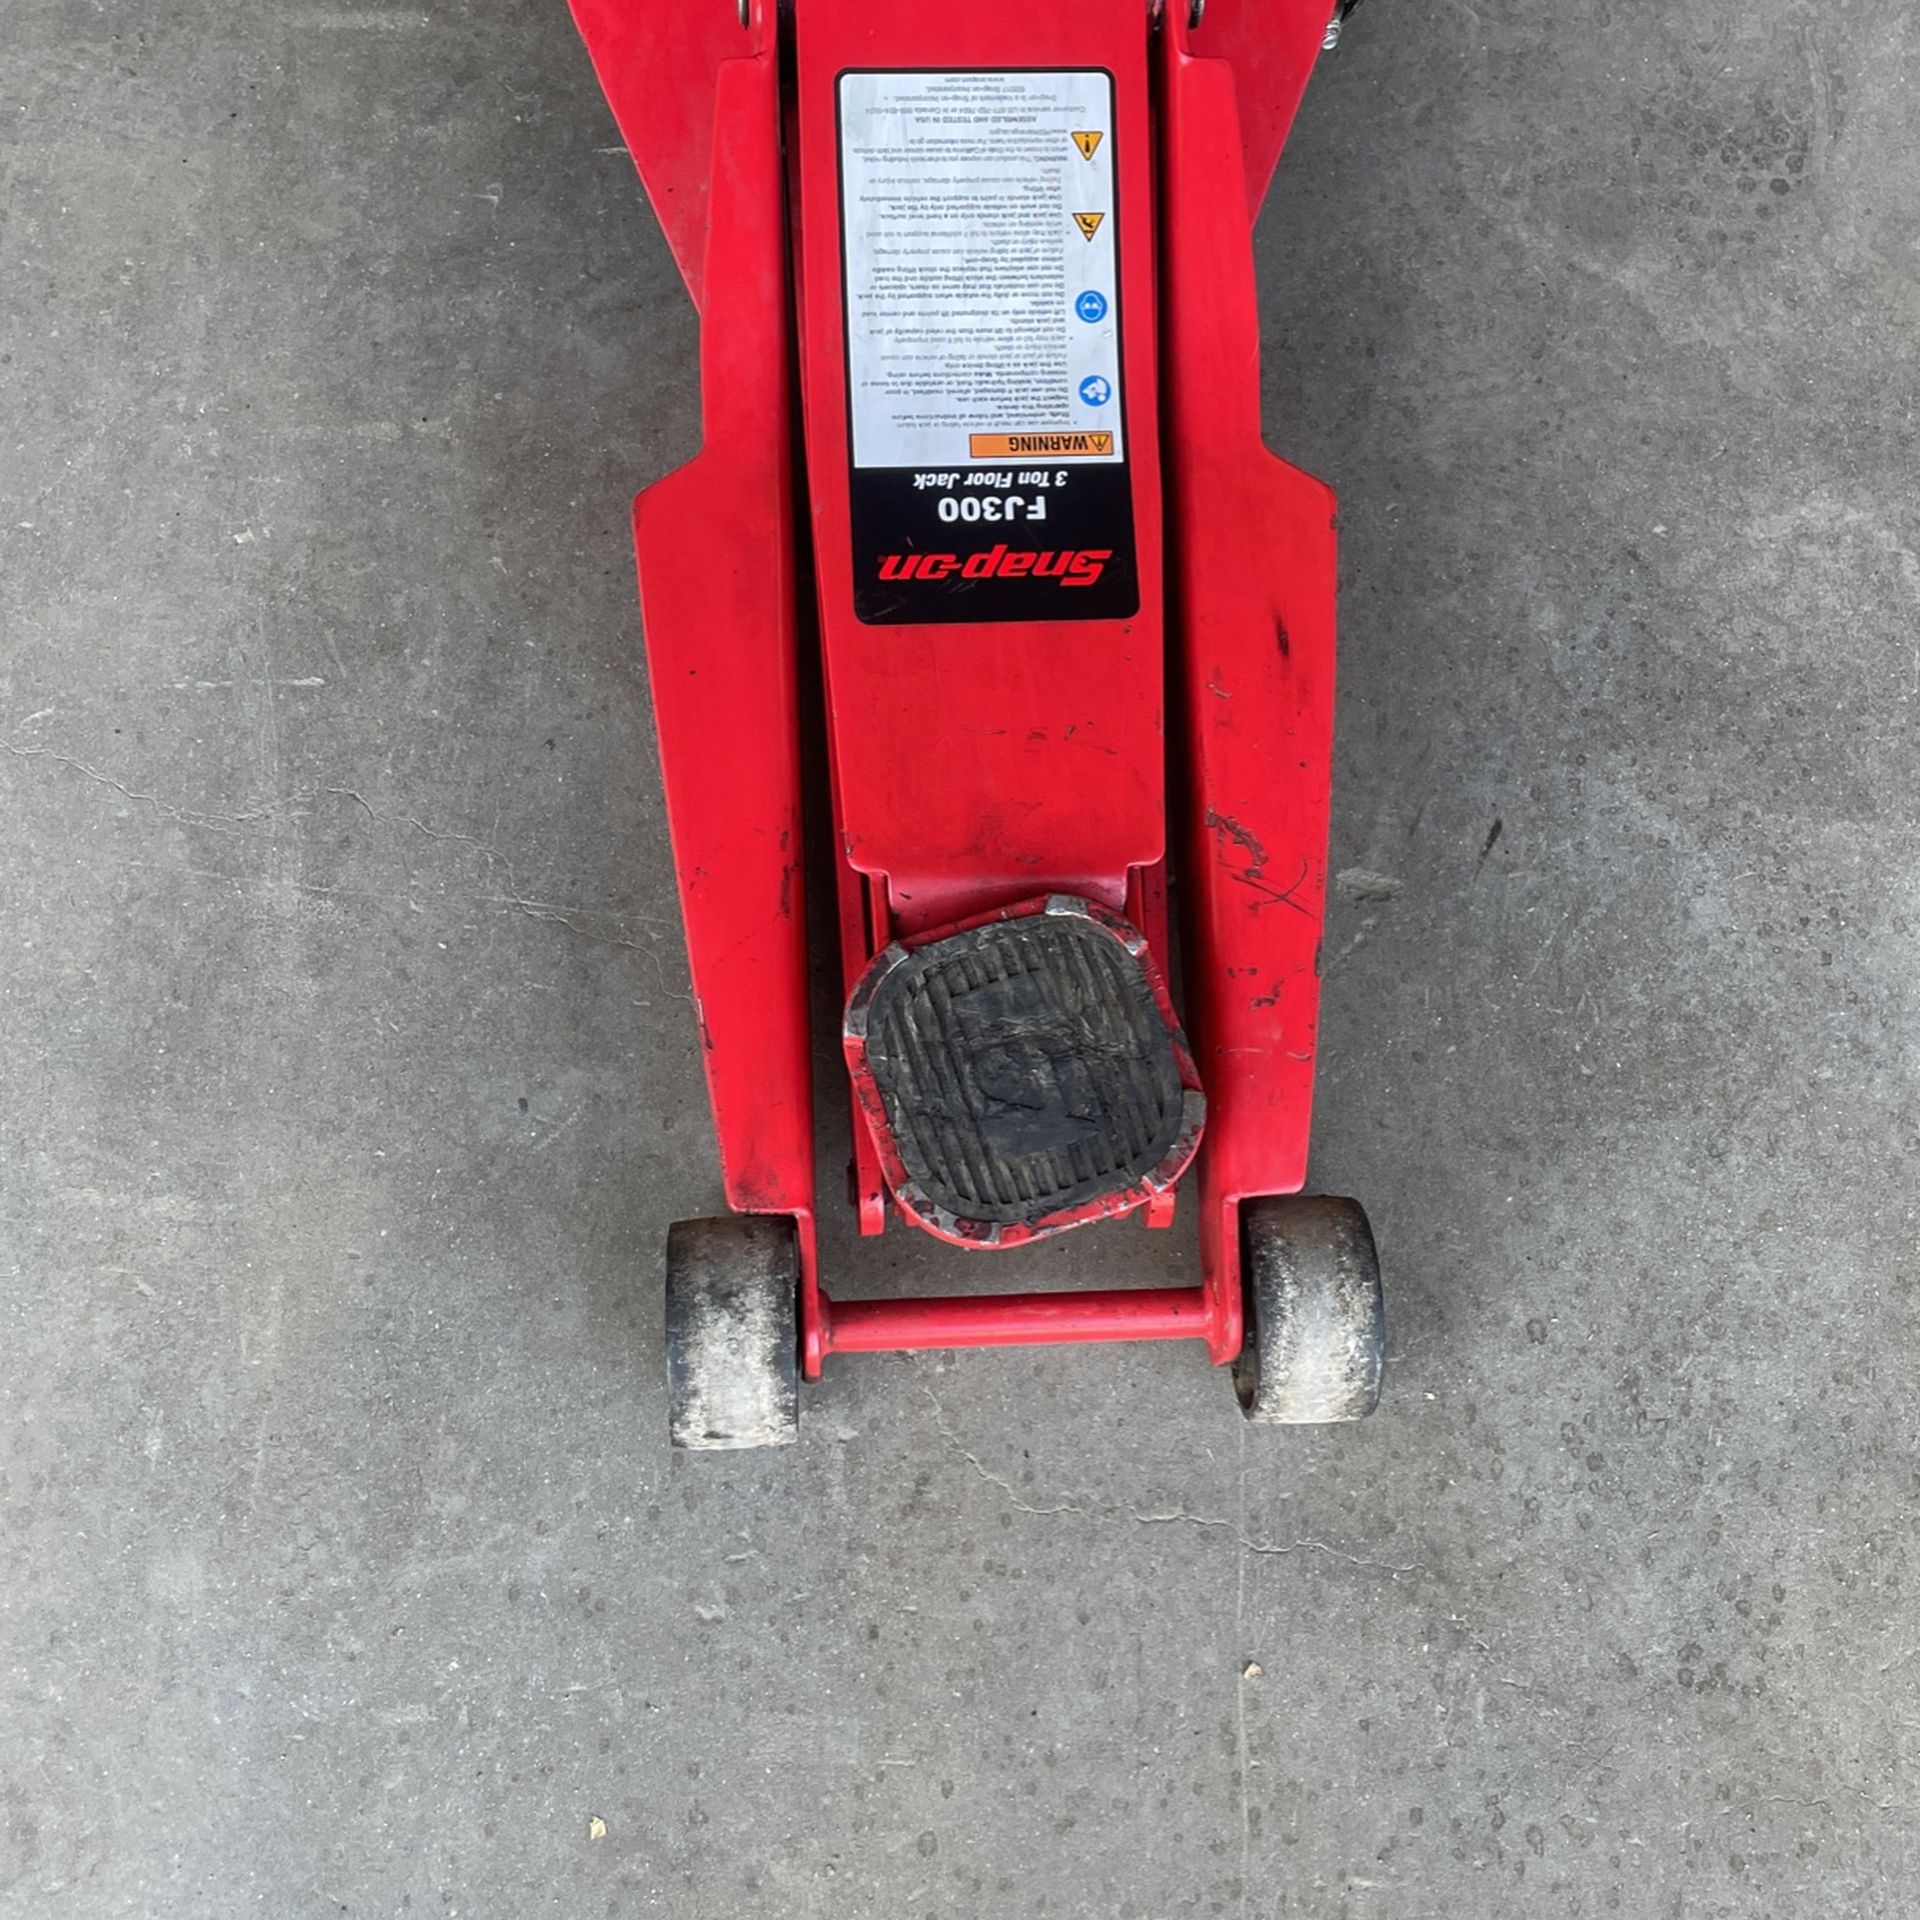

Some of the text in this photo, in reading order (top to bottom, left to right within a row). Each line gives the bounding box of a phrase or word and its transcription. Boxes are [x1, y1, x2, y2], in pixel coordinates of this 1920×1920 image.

[1010, 436, 1087, 451] WARNING
[914, 471, 1068, 490] 3 Ton Floor Jack
[938, 496, 1046, 522] FJ300
[879, 544, 1112, 586] Snap-on
